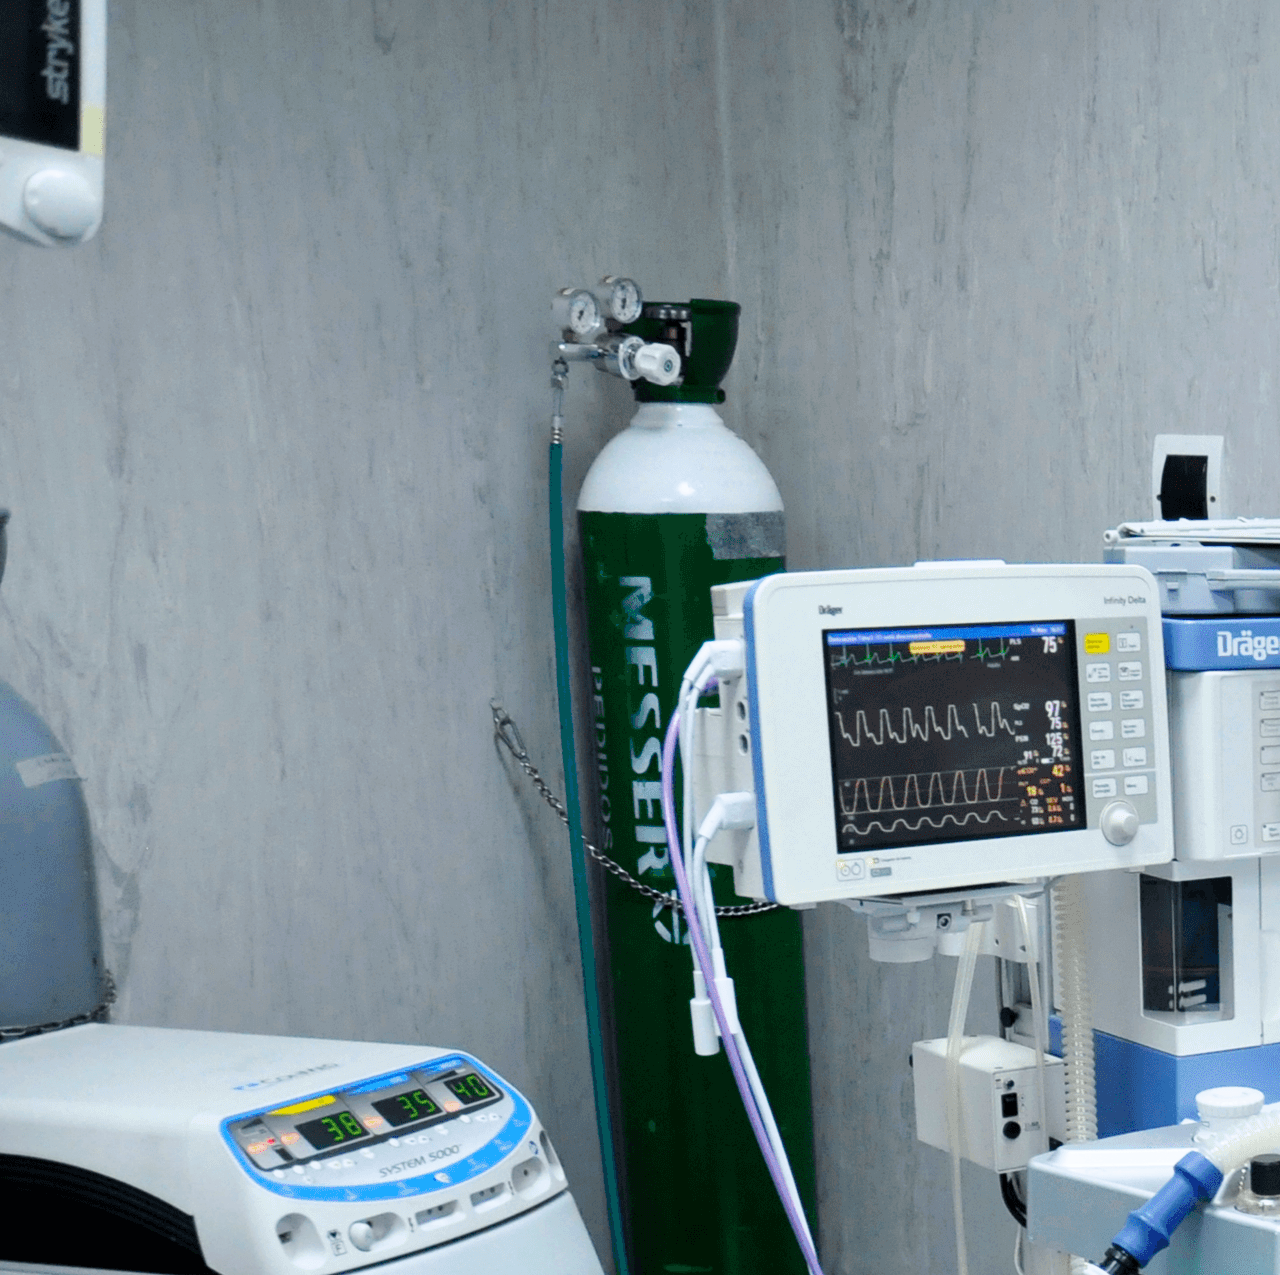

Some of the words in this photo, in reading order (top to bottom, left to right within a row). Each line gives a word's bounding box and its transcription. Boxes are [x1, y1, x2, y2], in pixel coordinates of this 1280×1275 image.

[41, 0, 74, 105] stryke
[1042, 636, 1058, 653] 75
[1045, 700, 1060, 718] 97
[619, 576, 671, 876] MESSER
[453, 1074, 489, 1098] 40
[398, 1090, 437, 1120] 35
[322, 1110, 362, 1142] 38
[379, 1155, 427, 1179] SYSTEM
[428, 1144, 460, 1160] 5000
